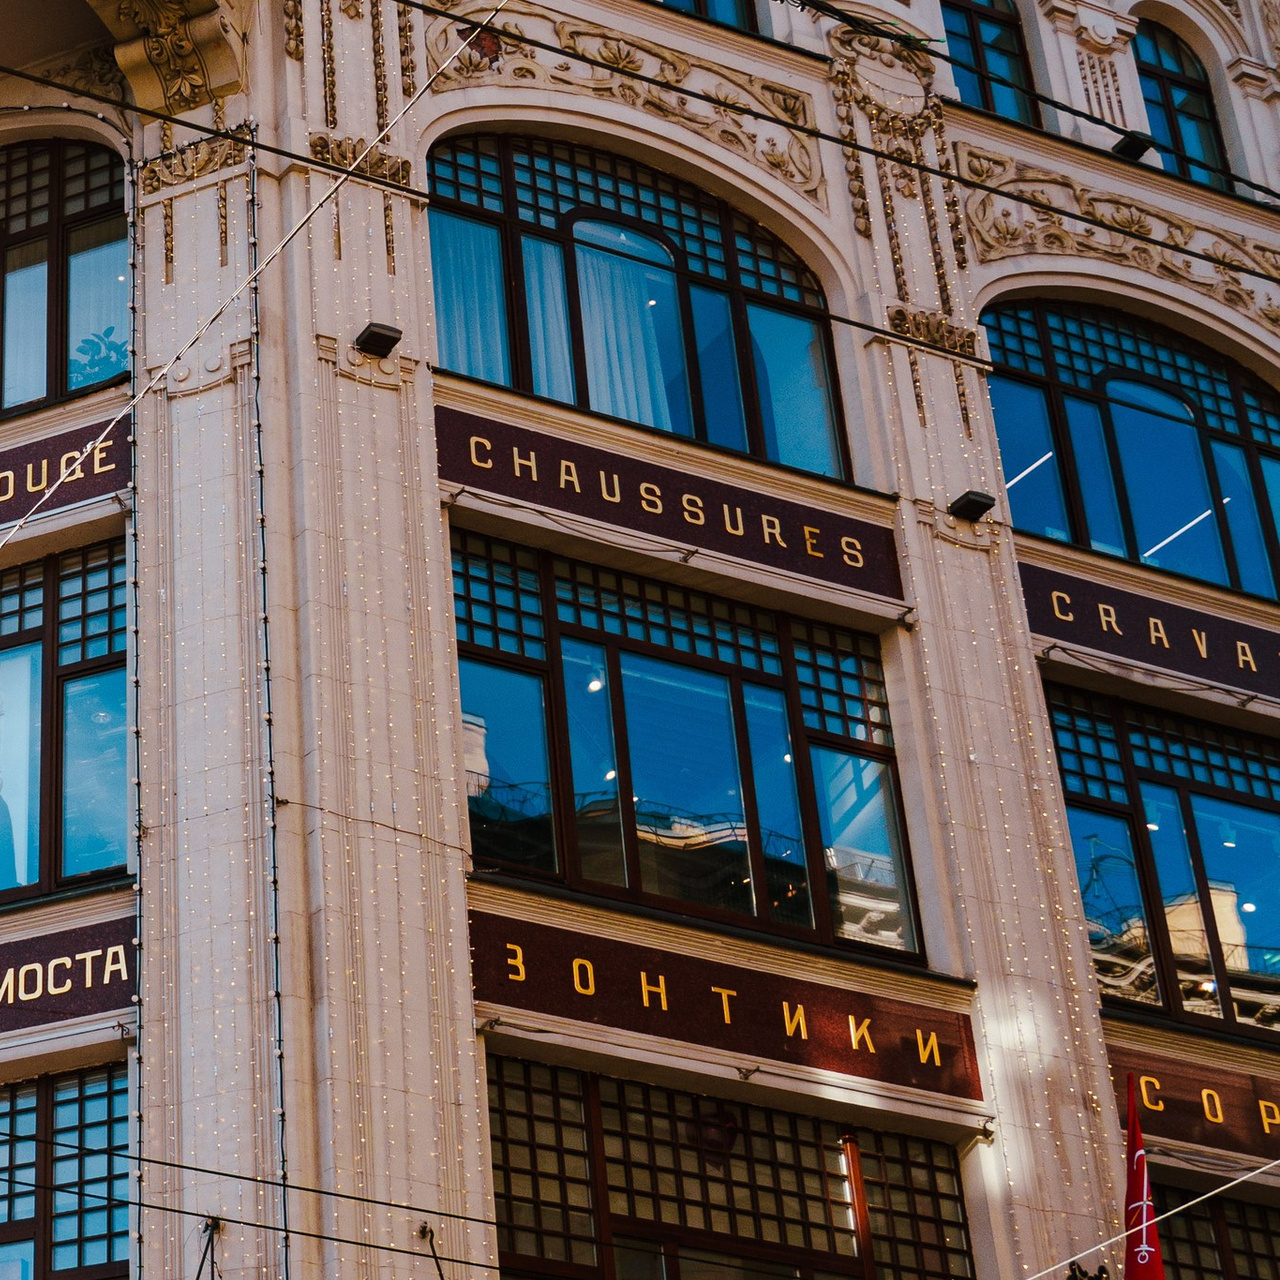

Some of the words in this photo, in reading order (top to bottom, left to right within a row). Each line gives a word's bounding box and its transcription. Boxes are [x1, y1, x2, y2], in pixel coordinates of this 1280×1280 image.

[469, 435, 865, 568] CHAUSSURES
[1051, 590, 1280, 673] CRAVA
[505, 942, 942, 1067] ЗОНТИКИ
